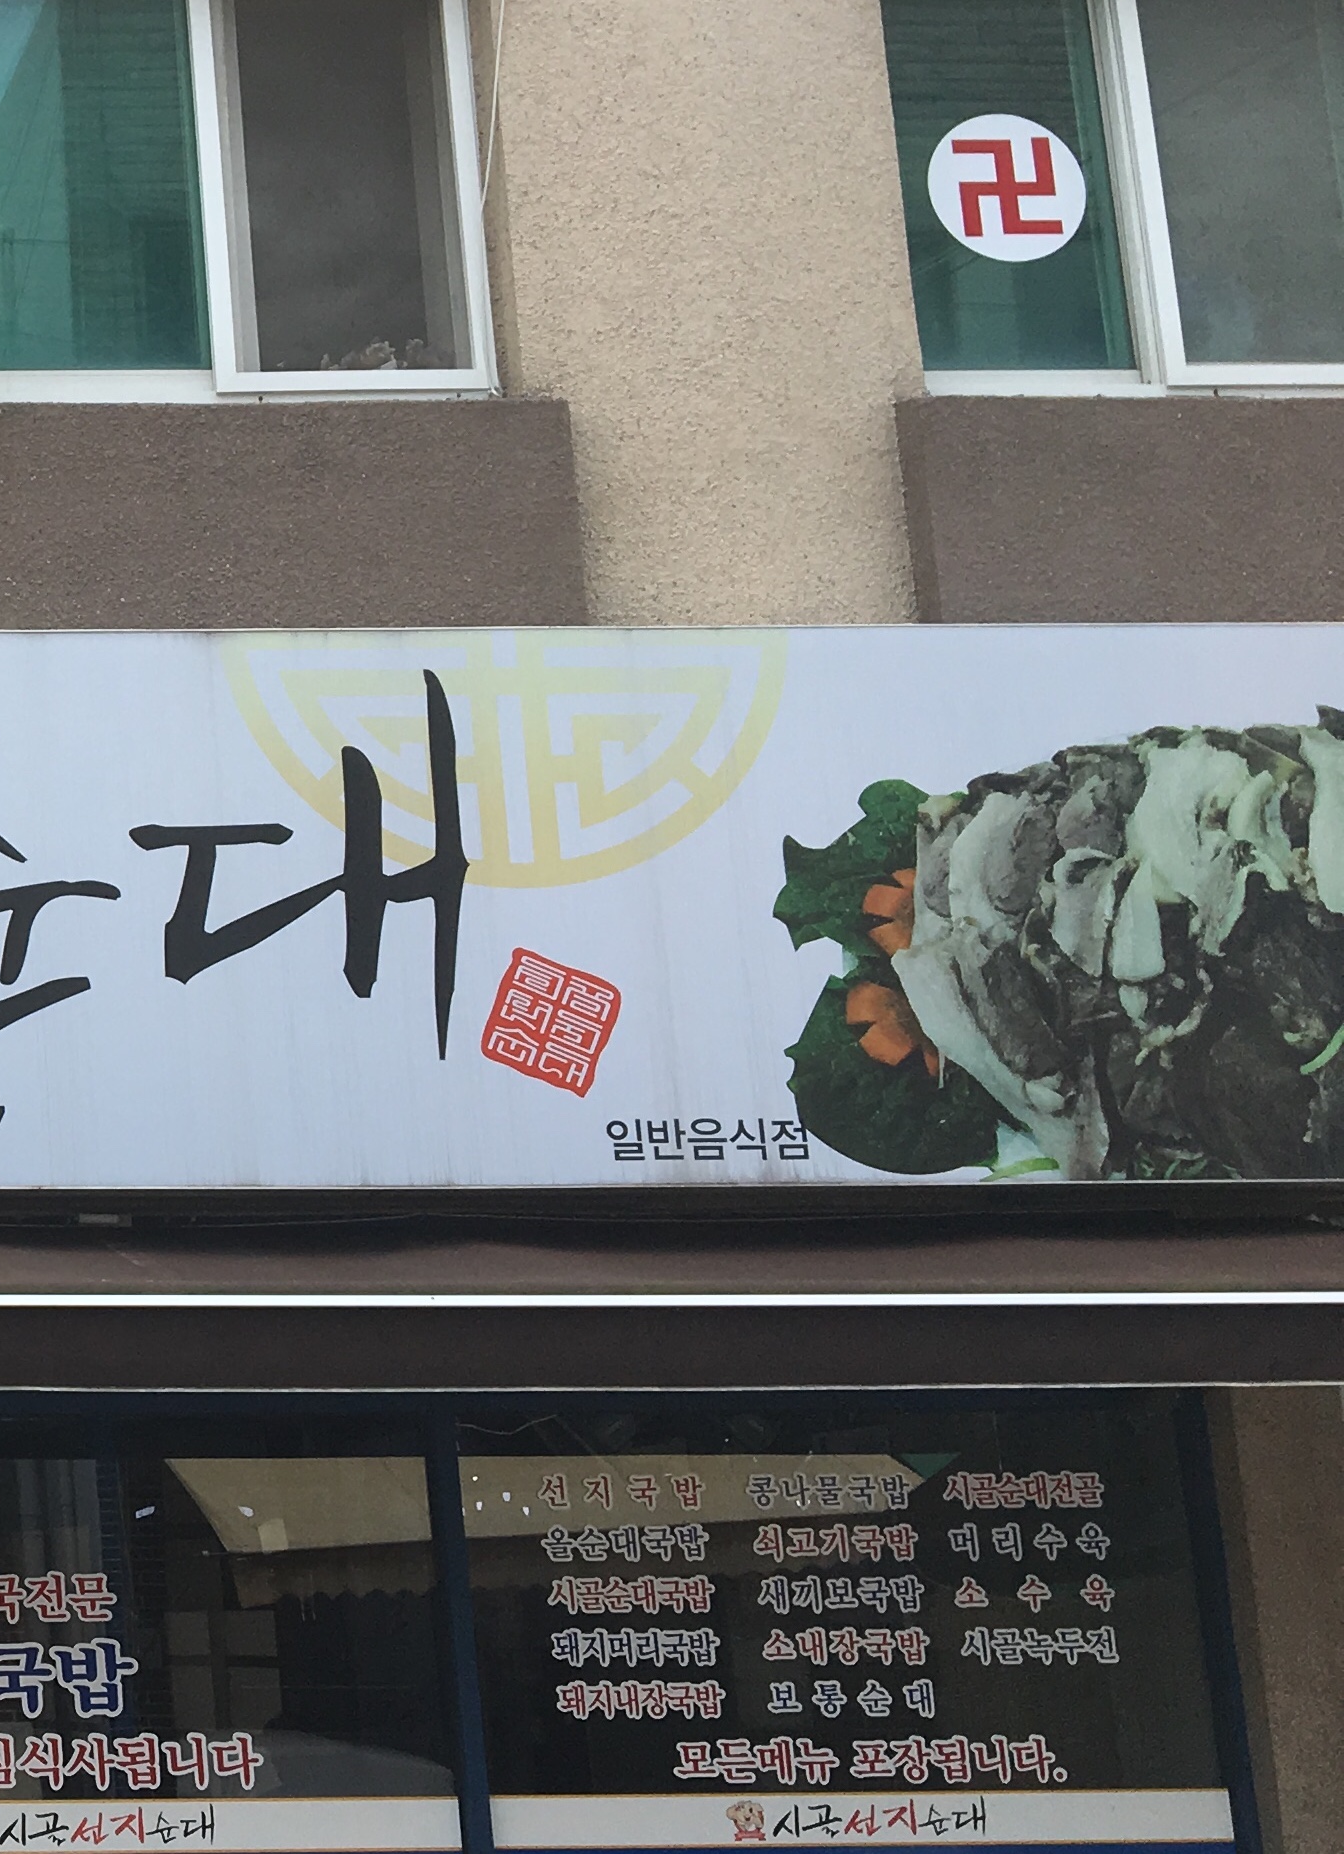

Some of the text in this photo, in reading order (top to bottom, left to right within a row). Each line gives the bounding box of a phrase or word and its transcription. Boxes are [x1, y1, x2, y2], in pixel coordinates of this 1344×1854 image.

[606, 1117, 810, 1161] 일반음식점
[748, 1475, 911, 1509] 콩나물국밥
[945, 1473, 1103, 1509] 시골순대전골
[755, 1524, 917, 1561] 쇠고기국밥
[550, 1577, 713, 1613] 시골순대국밥
[759, 1576, 923, 1613] 새끼보국밥
[554, 1629, 719, 1666] 돼지머리국밥
[763, 1628, 929, 1665] 소내장국밥
[962, 1627, 1119, 1665] 시골녹두전
[558, 1681, 724, 1719] 돼지내장국밥
[674, 1737, 1068, 1784] 모든메뉴 포장됩니다.
[0, 1803, 215, 1846] 시골선지순대
[773, 1795, 987, 1838] 시골선지순대
